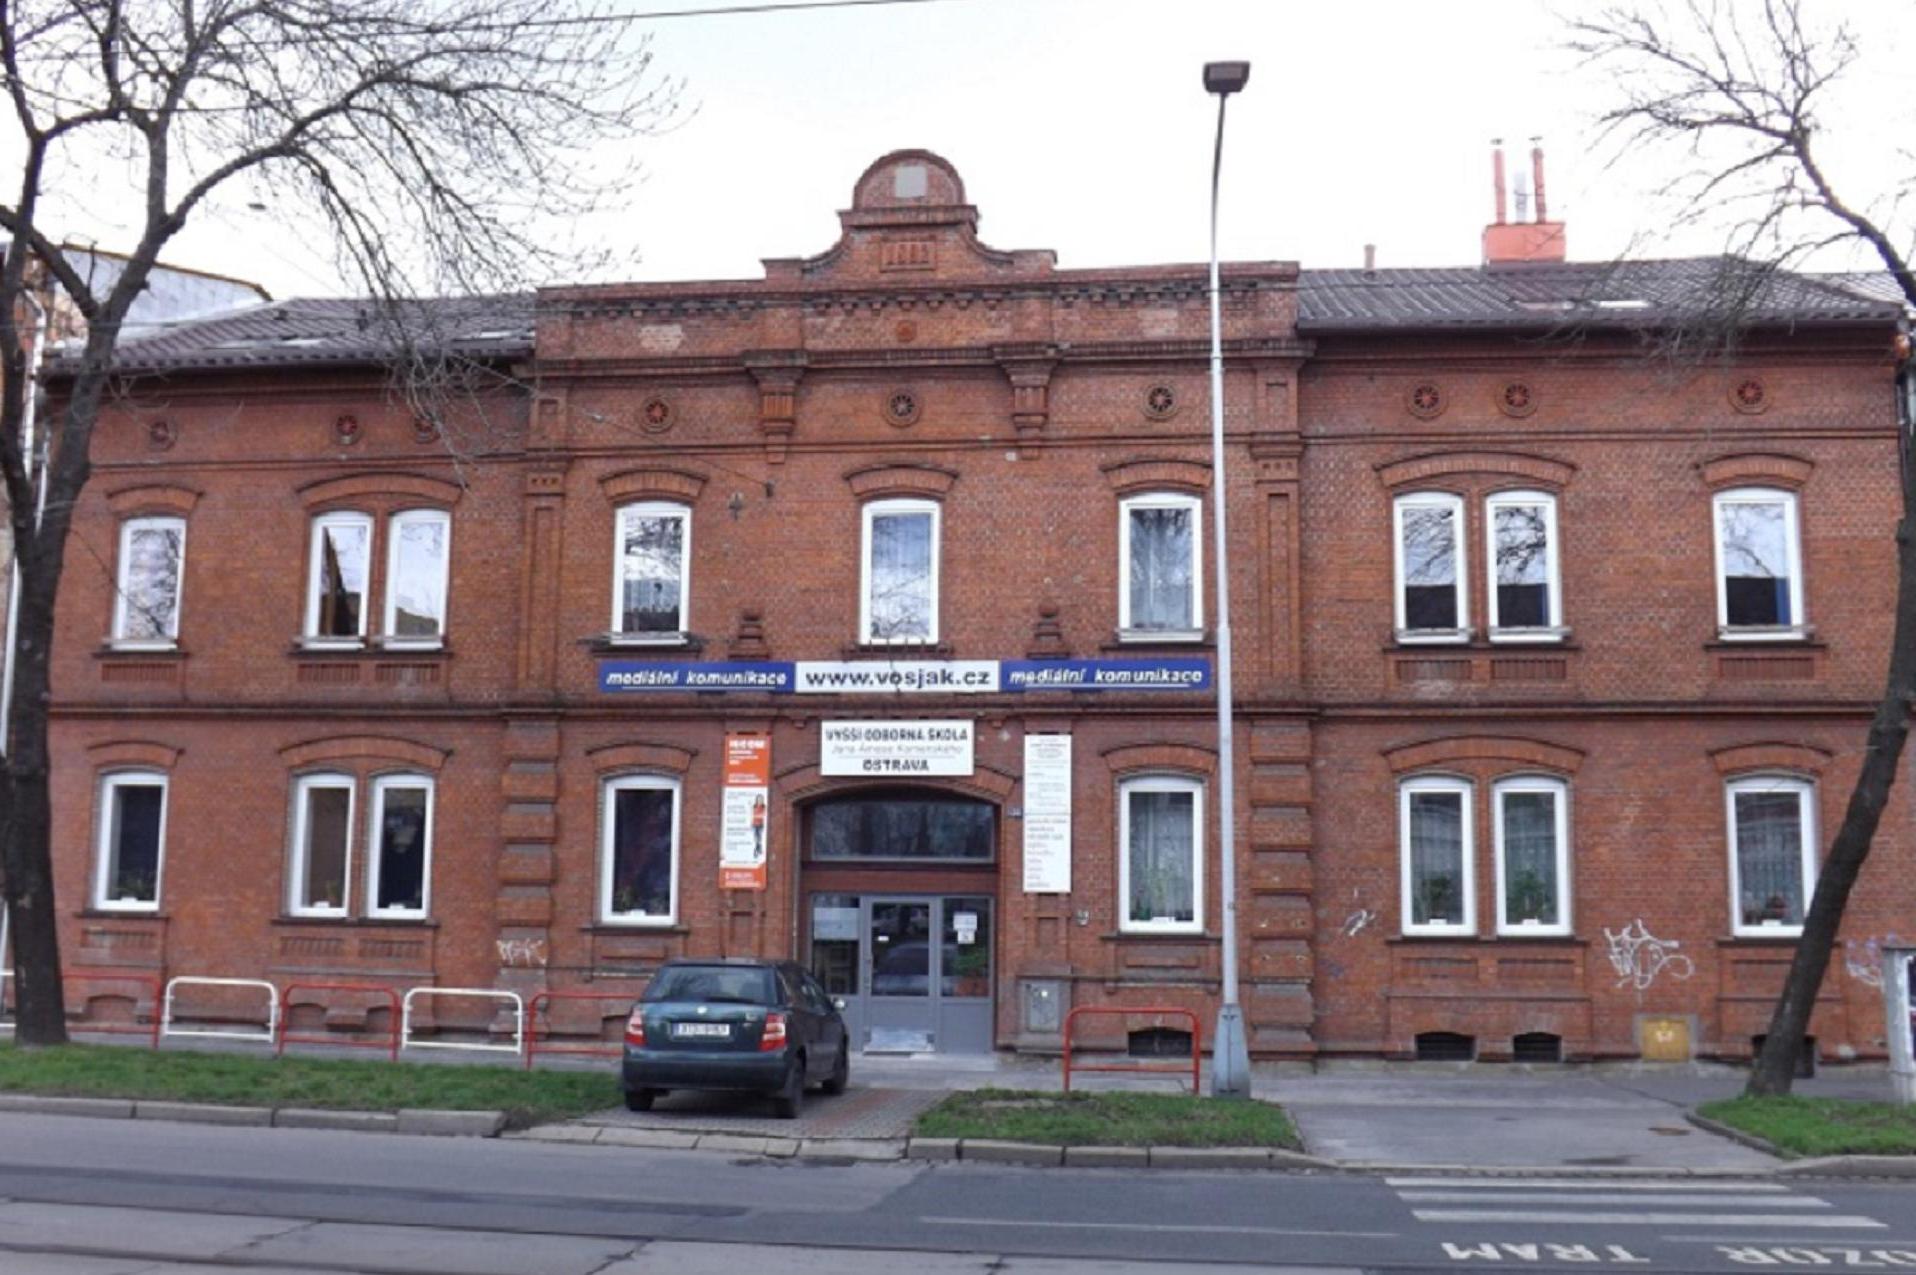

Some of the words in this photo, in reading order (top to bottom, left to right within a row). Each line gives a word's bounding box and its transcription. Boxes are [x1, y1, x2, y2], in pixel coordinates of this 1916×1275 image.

[686, 669, 788, 685] komunikace
[805, 668, 991, 689] www.vosjak.cz
[1094, 667, 1204, 684] komunikace
[862, 758, 930, 772] OSTRAVA
[1440, 1242, 1651, 1262] TRAM
